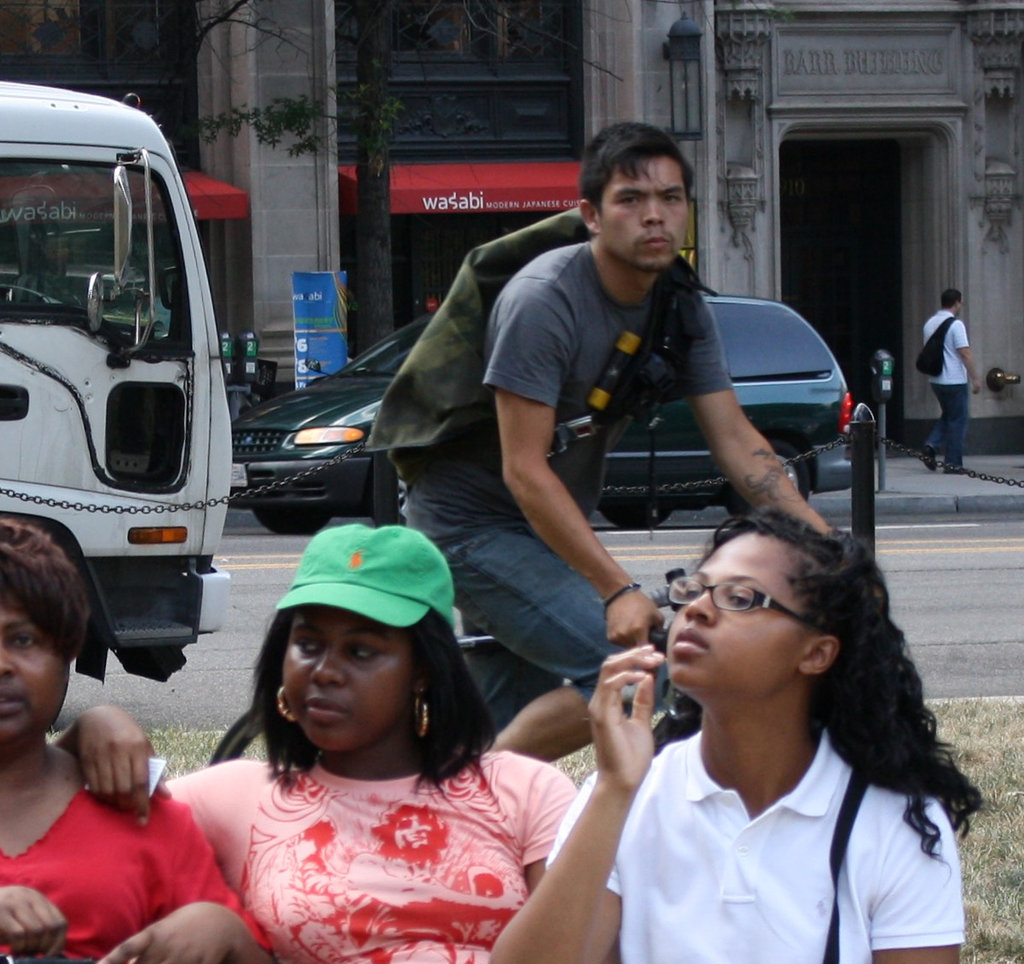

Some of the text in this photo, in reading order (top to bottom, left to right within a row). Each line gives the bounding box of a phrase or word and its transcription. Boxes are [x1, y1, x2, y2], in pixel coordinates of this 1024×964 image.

[783, 50, 838, 76] BARR
[422, 191, 484, 210] wasabi
[486, 201, 520, 209] MODERN
[522, 200, 560, 208] JAPANESE
